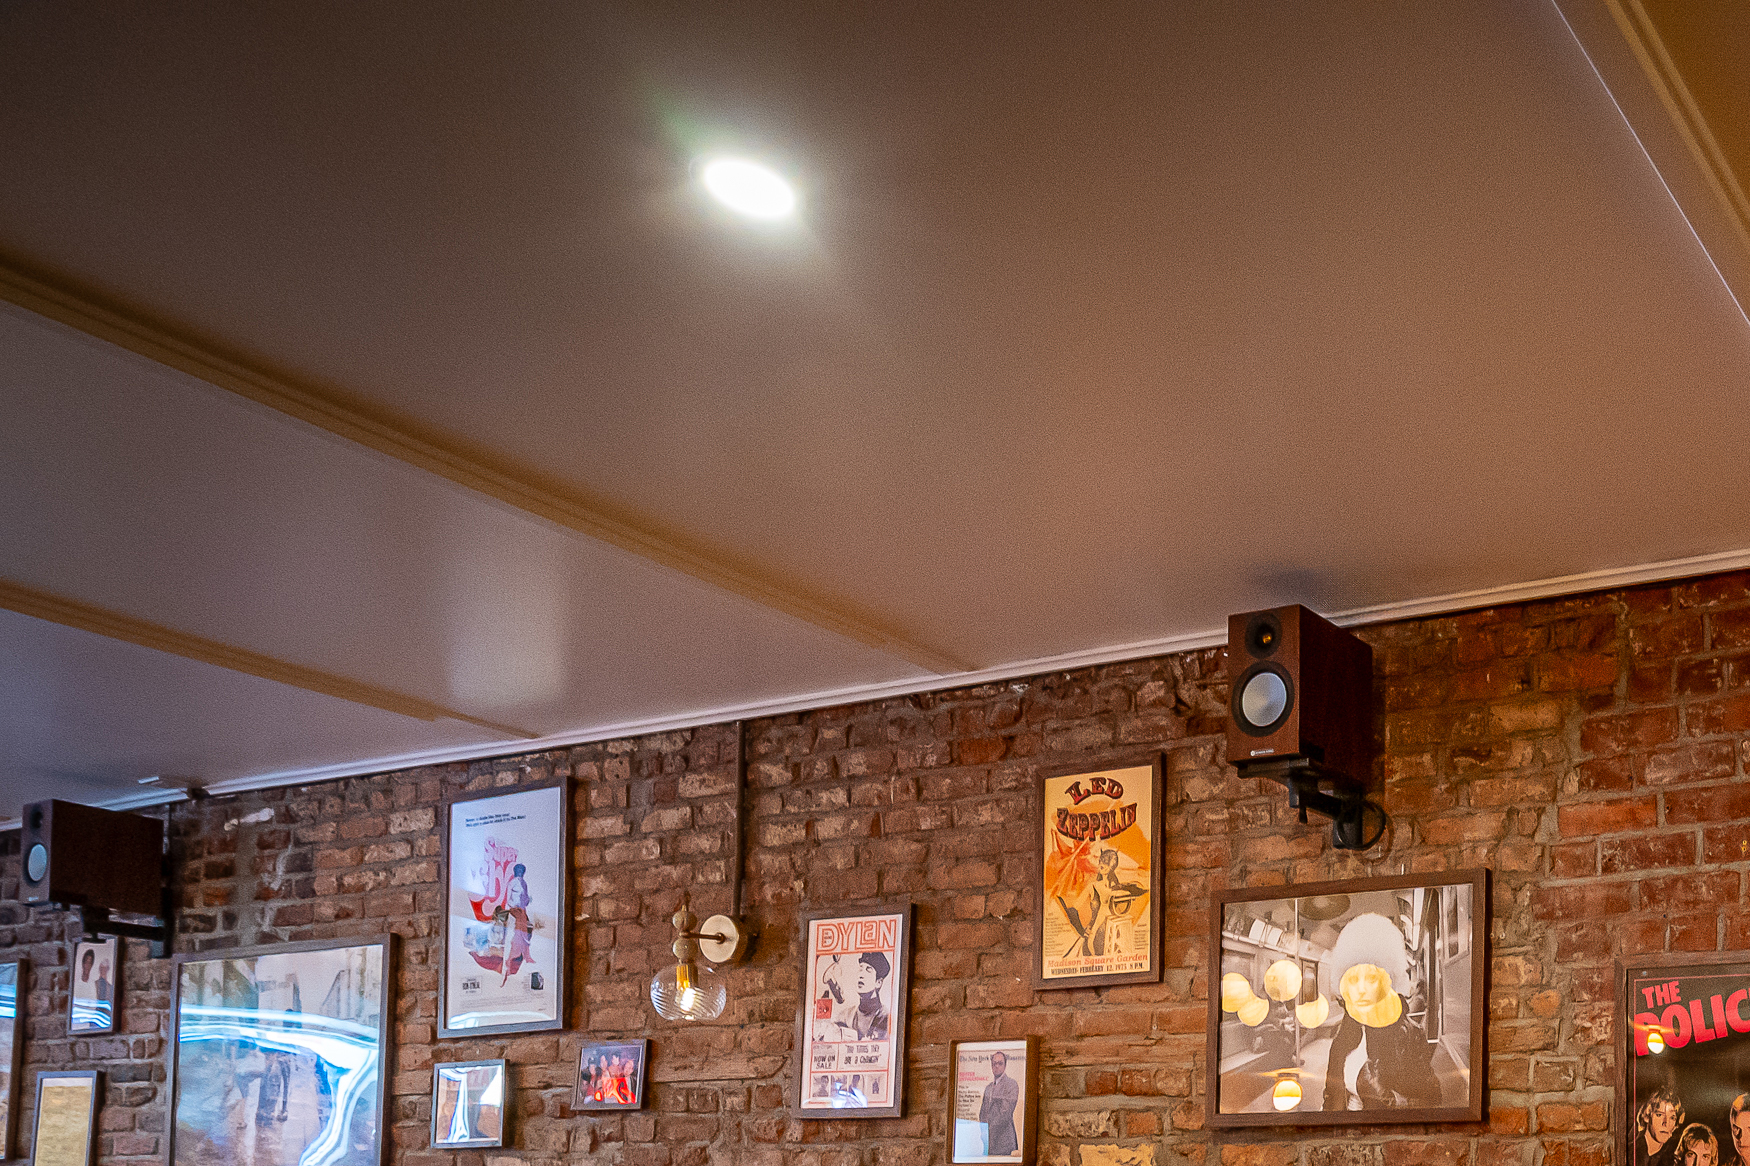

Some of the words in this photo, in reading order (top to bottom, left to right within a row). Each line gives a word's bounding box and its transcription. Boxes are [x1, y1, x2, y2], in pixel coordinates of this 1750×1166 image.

[1065, 776, 1124, 806] LED
[1056, 802, 1138, 842] ZEPPELIN
[1047, 959, 1082, 969] Madison
[1084, 956, 1114, 968] Square
[1117, 953, 1148, 962] Garden
[1641, 980, 1682, 1009] THE
[815, 1062, 832, 1070] SALE
[827, 1054, 836, 1062] ON
